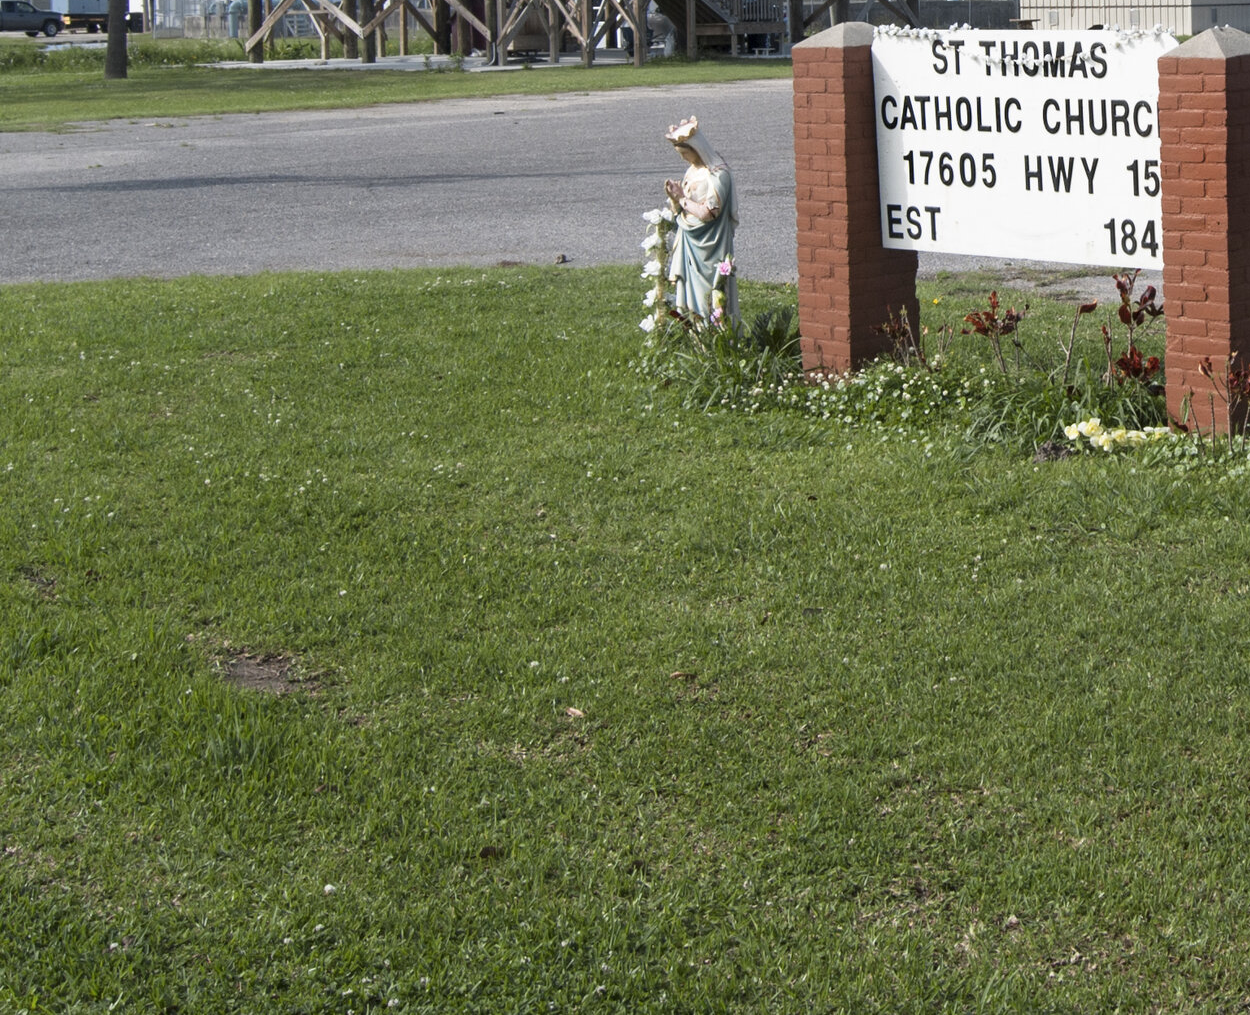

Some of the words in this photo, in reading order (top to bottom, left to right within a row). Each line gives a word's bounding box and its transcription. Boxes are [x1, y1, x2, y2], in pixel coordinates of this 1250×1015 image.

[931, 38, 965, 76] ST
[978, 40, 1109, 79] THOMAS
[880, 94, 1023, 134] CATHOLIC
[1042, 98, 1161, 139] CHURC
[903, 150, 999, 190] 17605
[1024, 155, 1100, 195] HWY
[886, 204, 942, 242] EST
